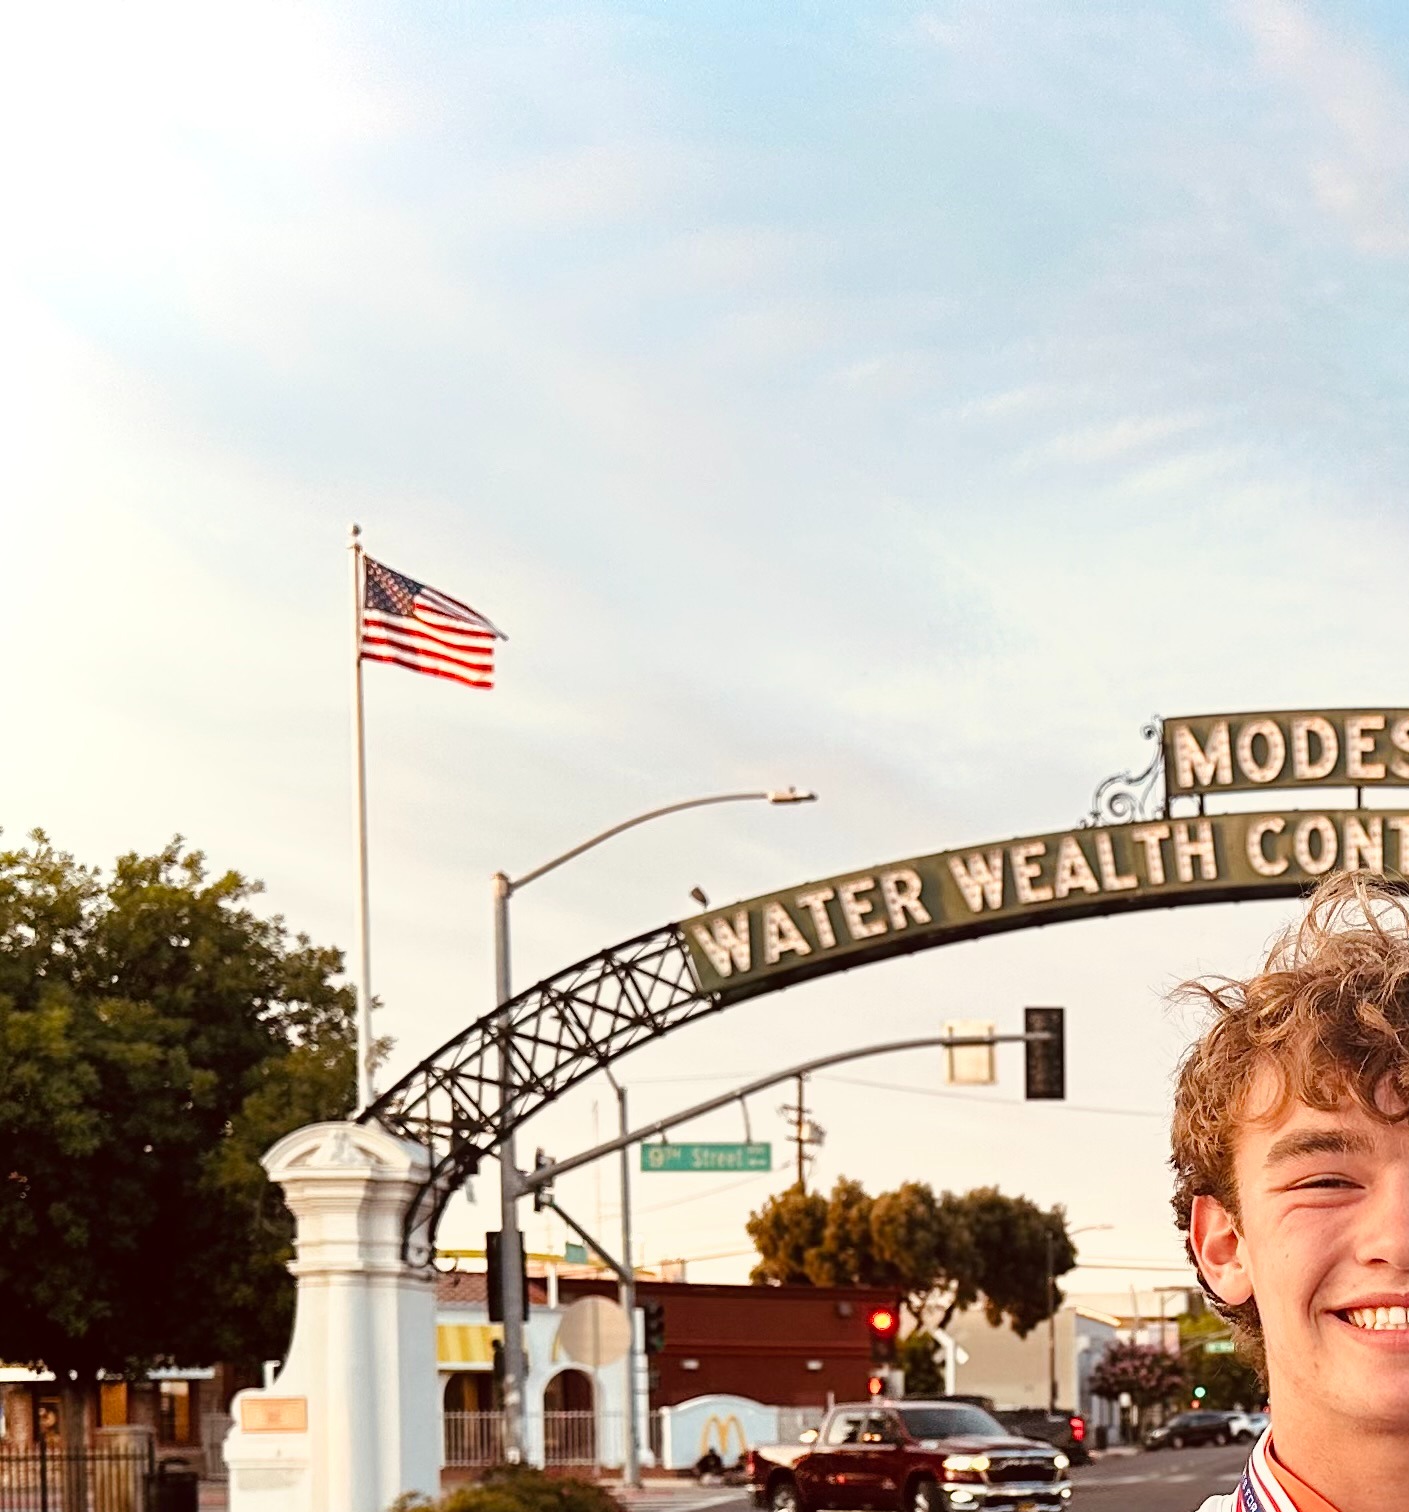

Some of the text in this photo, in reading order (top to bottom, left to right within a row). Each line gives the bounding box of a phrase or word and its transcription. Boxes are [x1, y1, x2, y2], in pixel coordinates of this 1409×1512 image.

[691, 868, 932, 978] WATER
[948, 818, 1219, 913] WEALTH
[692, 1147, 742, 1168] Street
